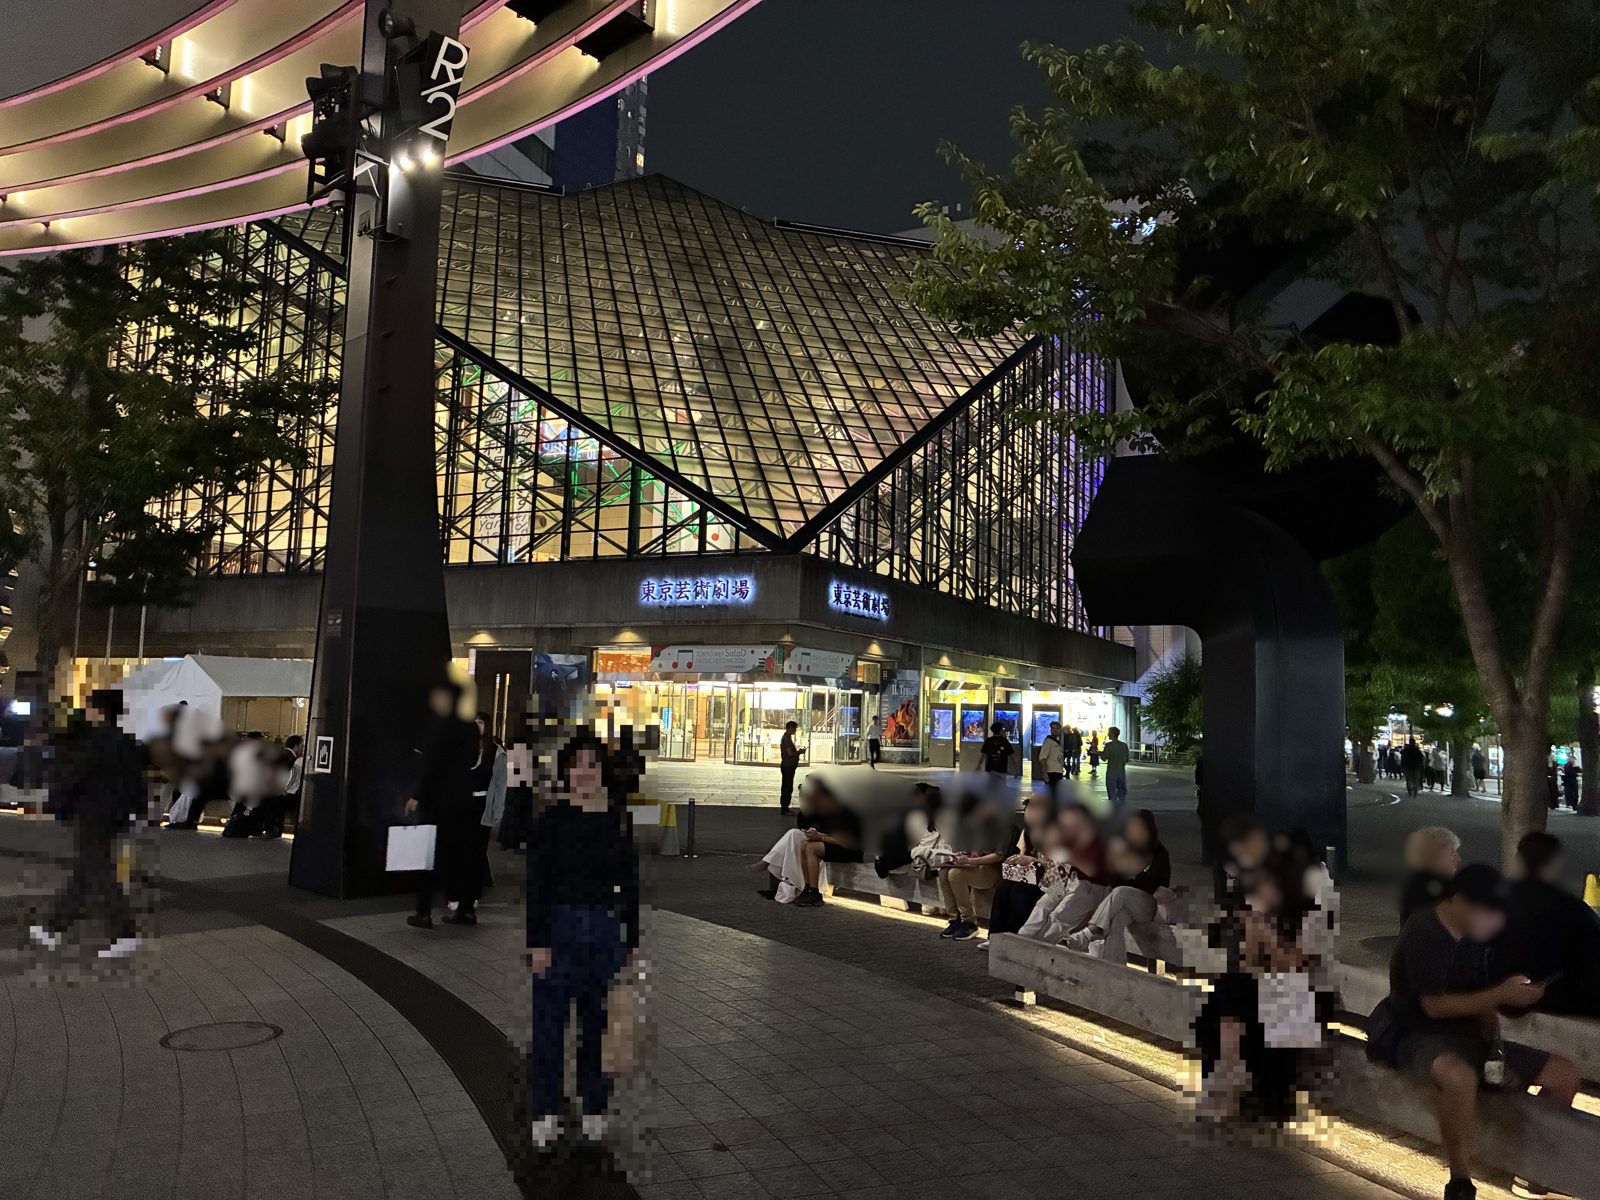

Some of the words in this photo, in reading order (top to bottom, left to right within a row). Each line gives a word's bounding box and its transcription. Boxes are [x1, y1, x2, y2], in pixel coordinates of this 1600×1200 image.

[640, 578, 750, 602] 東京芸術劇場
[832, 583, 891, 617] 東京芸術劇場
